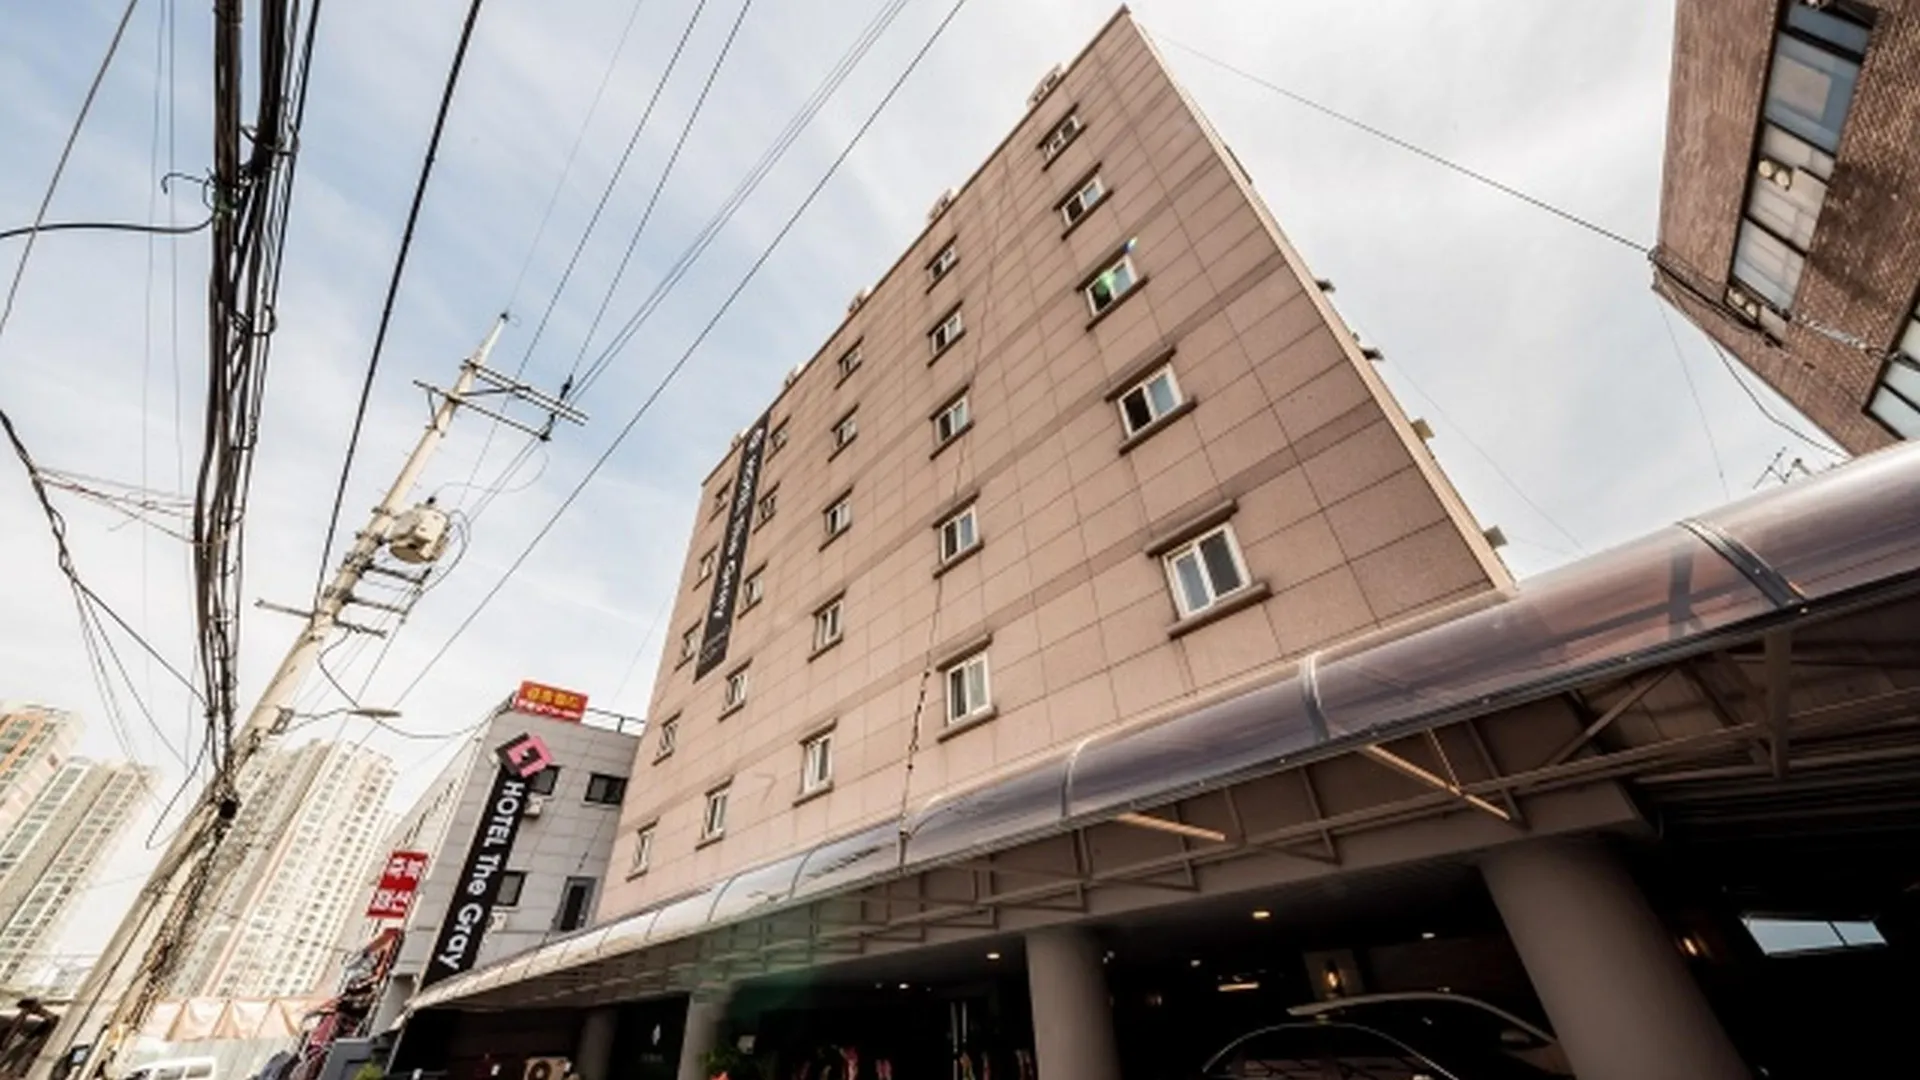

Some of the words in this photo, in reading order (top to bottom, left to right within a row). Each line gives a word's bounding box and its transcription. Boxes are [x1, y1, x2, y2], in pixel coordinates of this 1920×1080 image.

[482, 780, 525, 847] HOTEL
[467, 854, 501, 895] The
[438, 903, 483, 970] Gray
